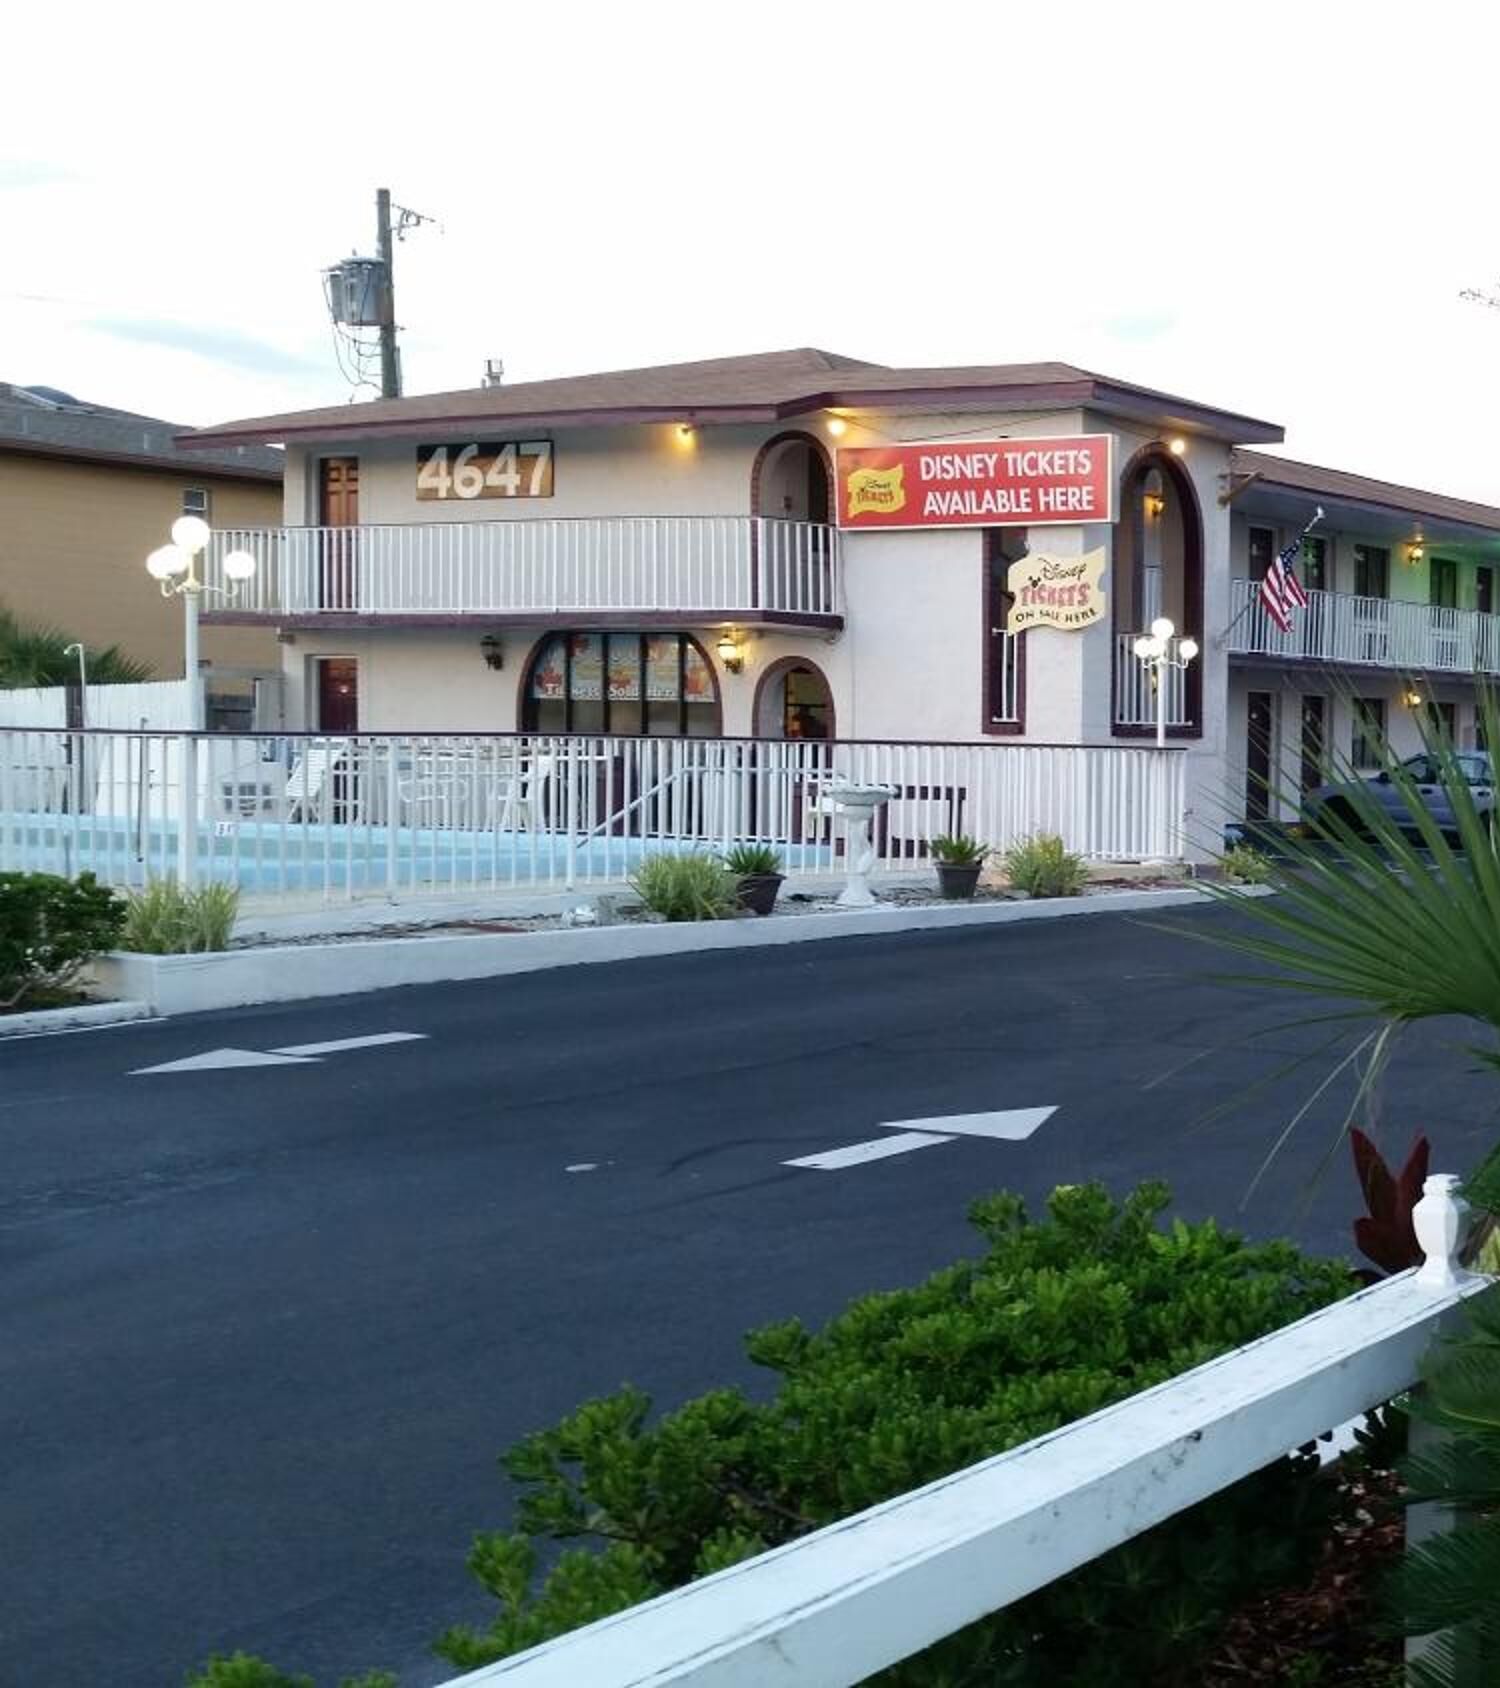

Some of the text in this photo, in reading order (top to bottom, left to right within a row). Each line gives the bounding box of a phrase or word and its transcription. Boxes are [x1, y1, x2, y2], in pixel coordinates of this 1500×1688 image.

[417, 443, 552, 498] 4647
[919, 450, 1093, 481] DISNEY TICKETS
[923, 486, 1095, 516] AVAILABLE HERE
[1038, 557, 1087, 581] Disney
[1021, 582, 1091, 608] TICKETS
[1016, 612, 1035, 623] ON
[1065, 607, 1096, 623] HERE
[608, 683, 639, 697] Sold
